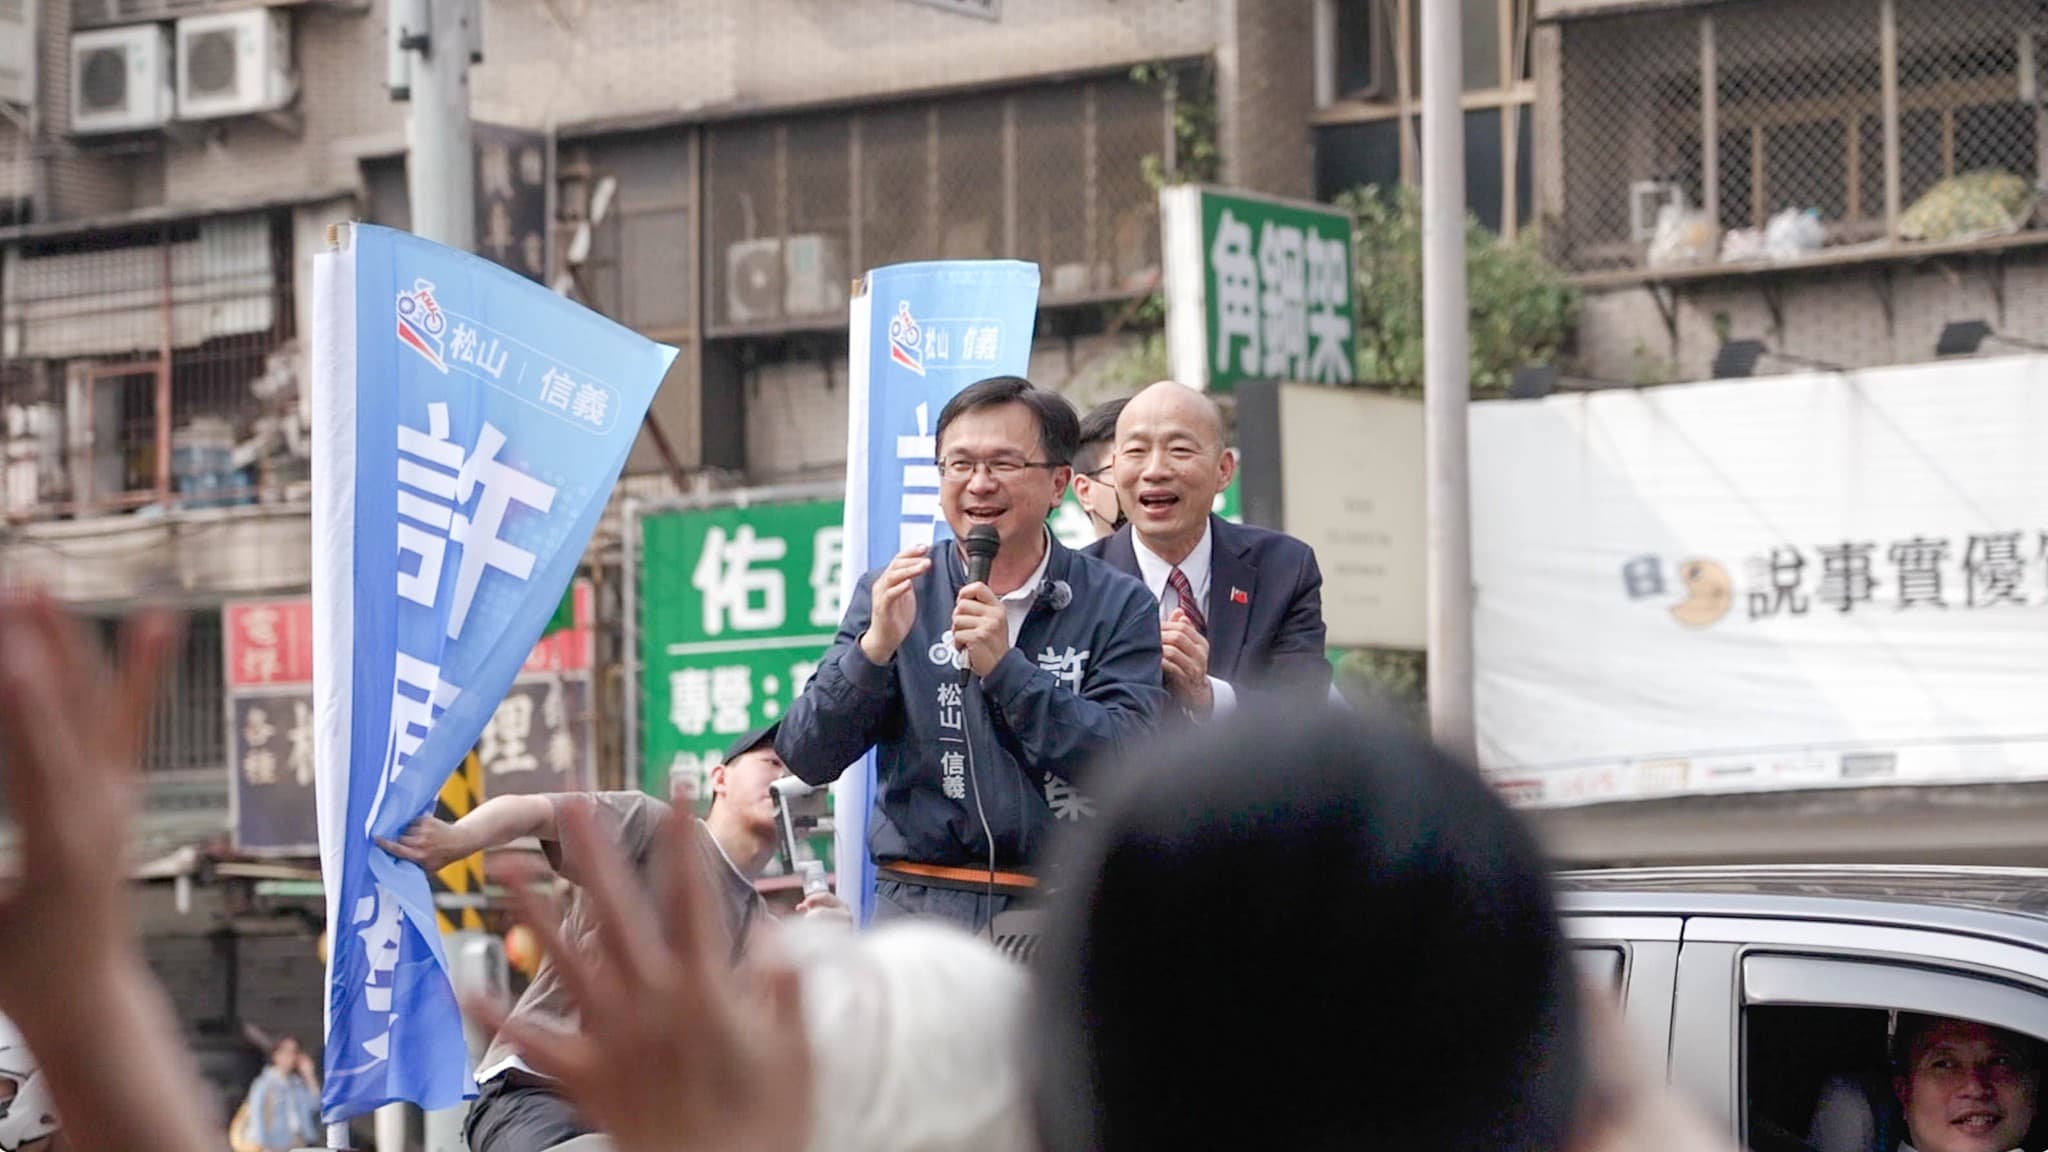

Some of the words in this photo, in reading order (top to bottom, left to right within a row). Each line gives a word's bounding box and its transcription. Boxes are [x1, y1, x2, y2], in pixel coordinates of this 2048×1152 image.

[1211, 207, 1351, 385] 角鋼架
[450, 323, 508, 379] 松山
[539, 367, 608, 427] 信義
[1744, 529, 2048, 621] 說事實優
[937, 682, 963, 731] 松山
[940, 751, 966, 800] 信義
